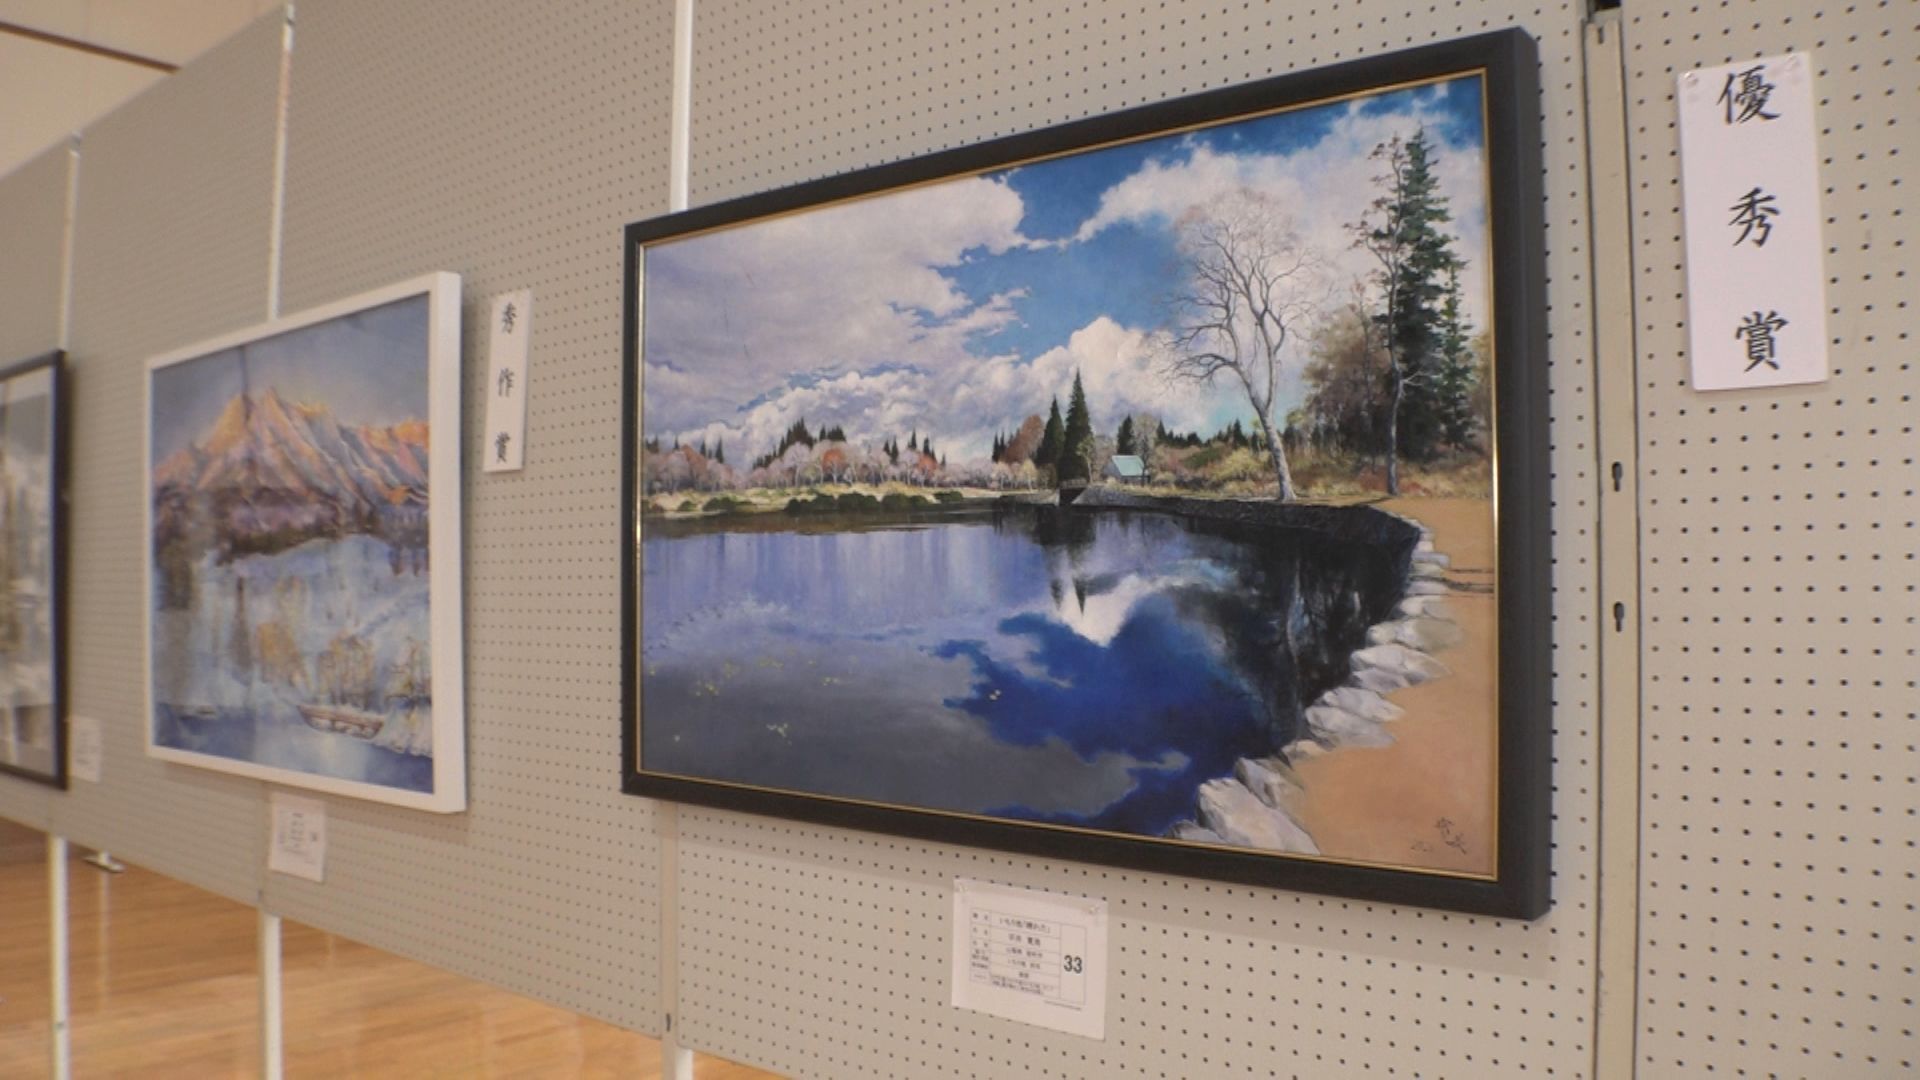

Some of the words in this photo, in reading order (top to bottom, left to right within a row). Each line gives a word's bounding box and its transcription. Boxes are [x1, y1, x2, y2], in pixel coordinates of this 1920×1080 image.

[1716, 64, 1789, 373] 優秀賞
[495, 302, 517, 463] 秀作賞
[1063, 954, 1083, 974] 33
